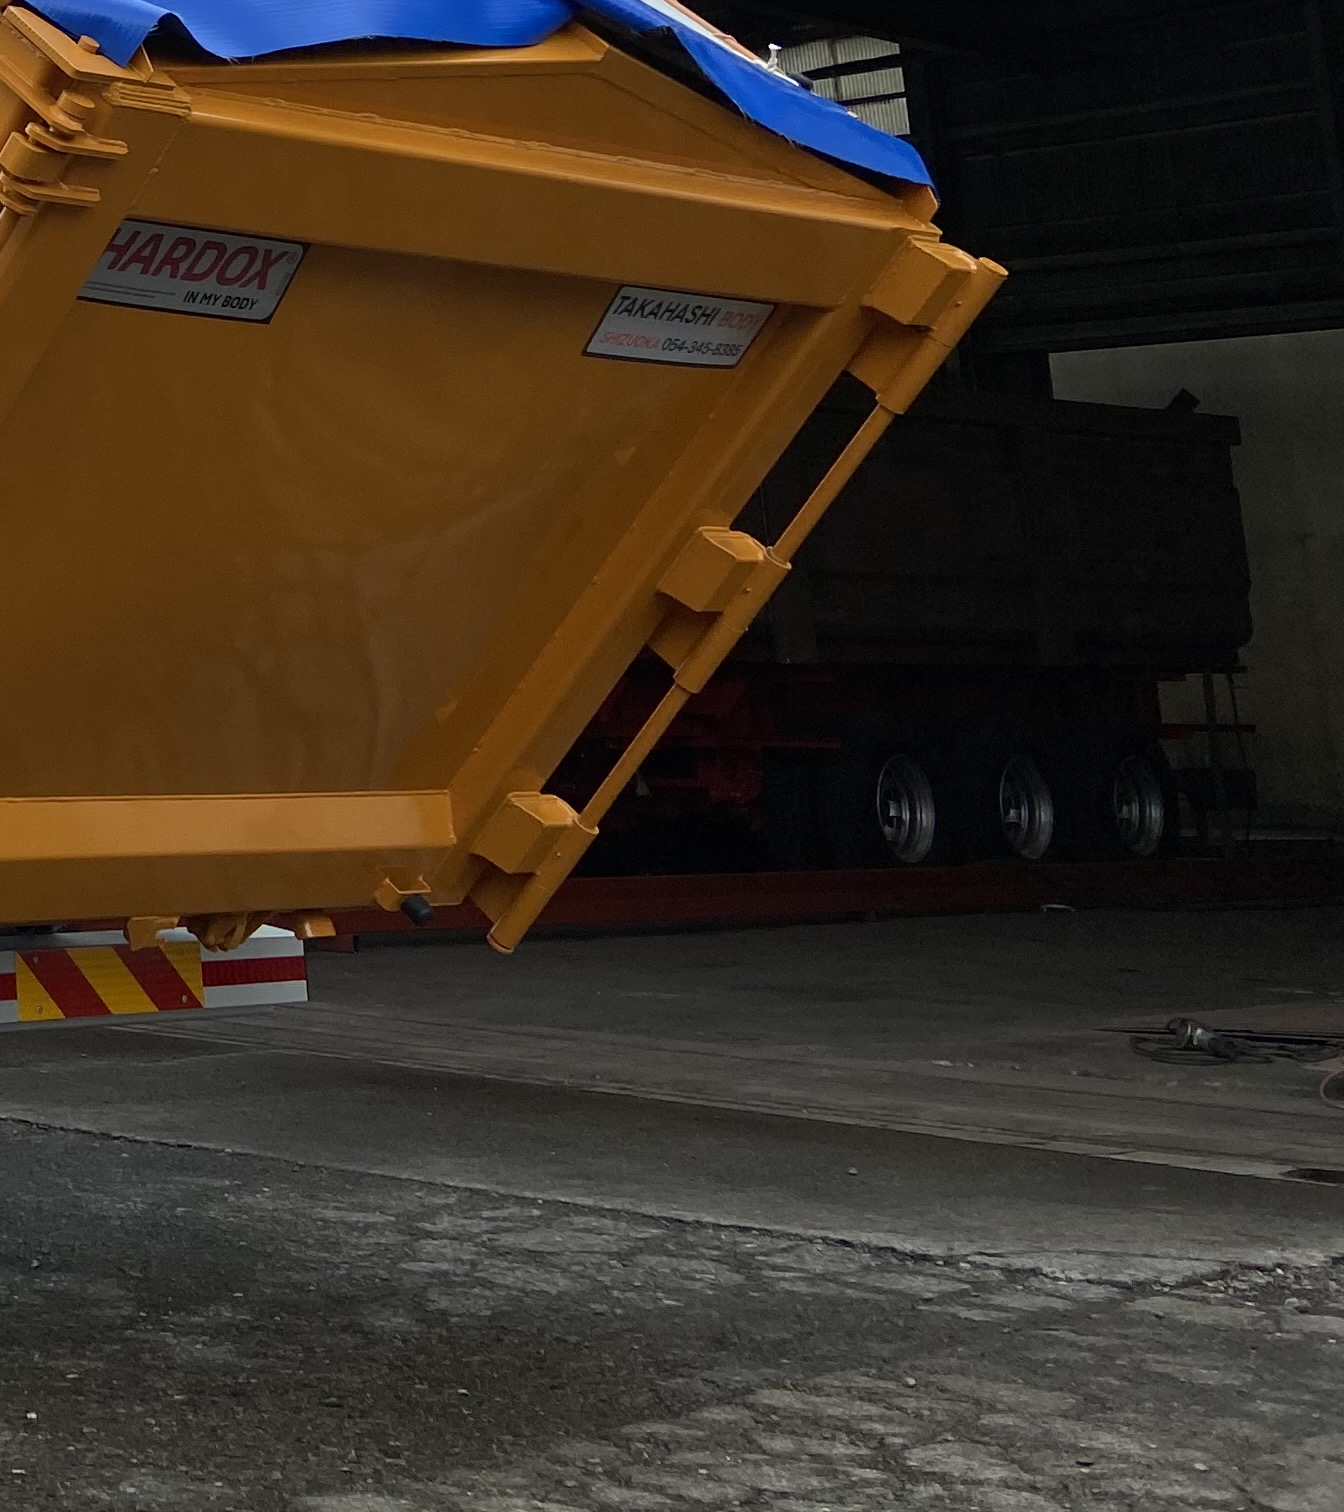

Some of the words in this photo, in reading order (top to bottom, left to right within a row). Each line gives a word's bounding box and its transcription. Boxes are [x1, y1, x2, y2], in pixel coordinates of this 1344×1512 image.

[183, 291, 198, 303] IN
[200, 293, 223, 306] MY
[222, 295, 258, 310] BODY
[613, 296, 721, 326] TAKAHASHI
[718, 311, 763, 329] BODY
